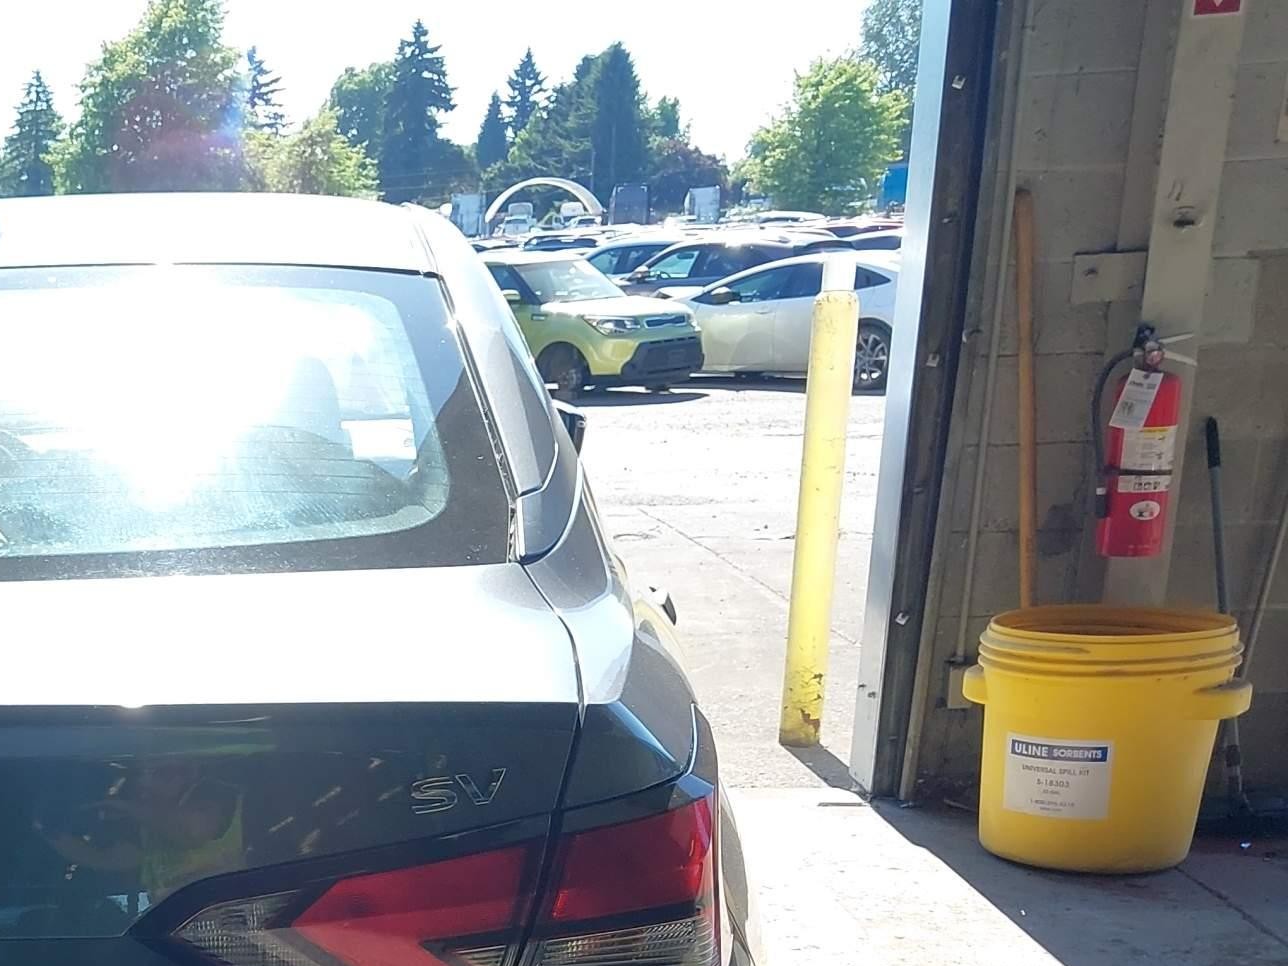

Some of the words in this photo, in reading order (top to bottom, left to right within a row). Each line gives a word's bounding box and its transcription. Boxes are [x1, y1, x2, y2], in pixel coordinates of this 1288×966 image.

[1015, 742, 1049, 757] ULINE
[1053, 748, 1102, 759] SORBENTS
[410, 768, 507, 814] SV
